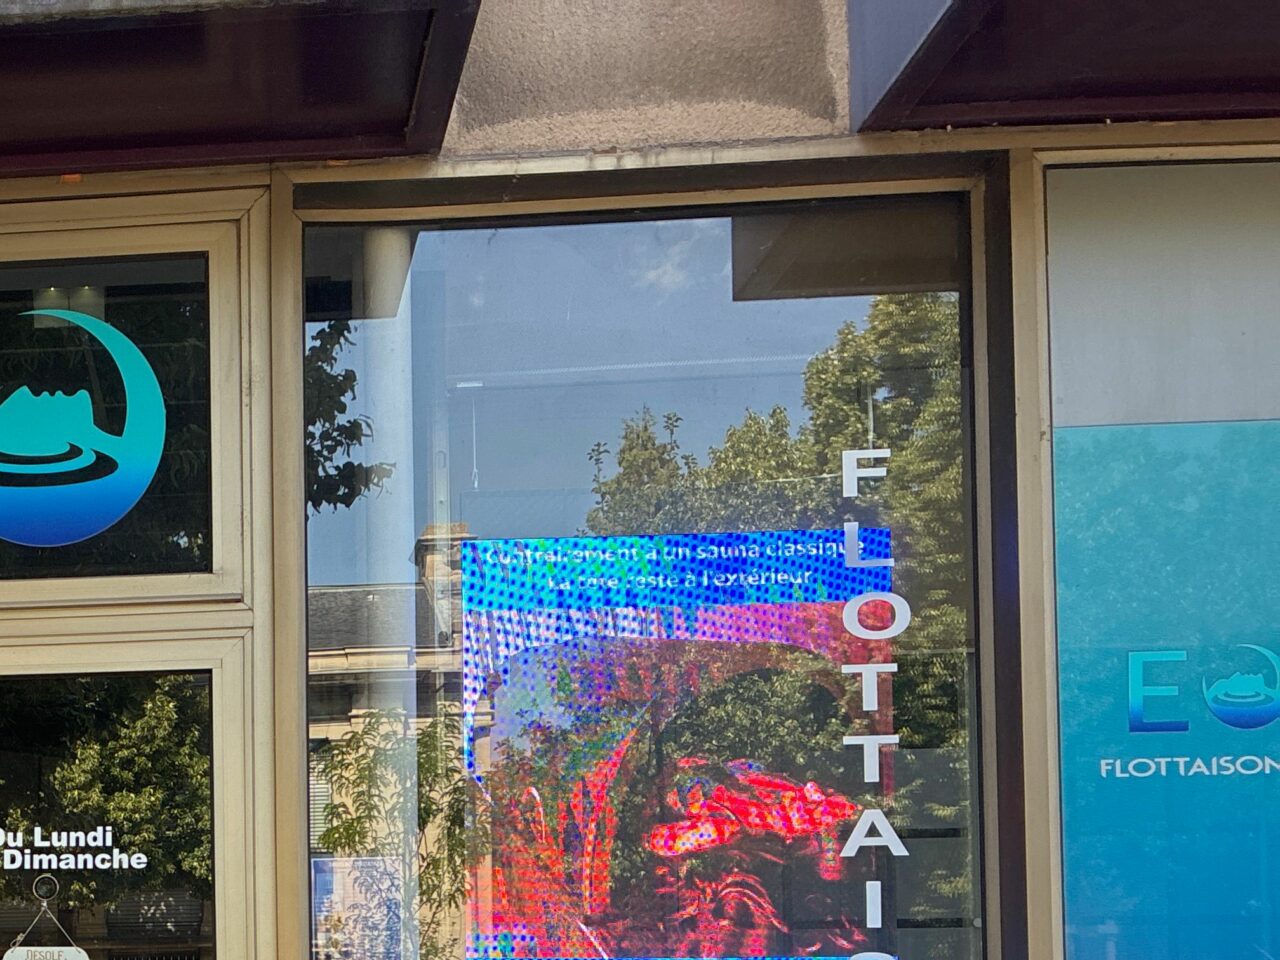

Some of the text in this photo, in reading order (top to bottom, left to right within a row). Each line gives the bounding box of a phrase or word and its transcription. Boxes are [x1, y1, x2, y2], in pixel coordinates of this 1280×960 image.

[663, 545, 690, 560] un
[697, 543, 760, 559] sauna
[1100, 755, 1280, 778] FLOTTAISON
[34, 826, 113, 848] Lundi
[3, 848, 148, 870] Dimanche
